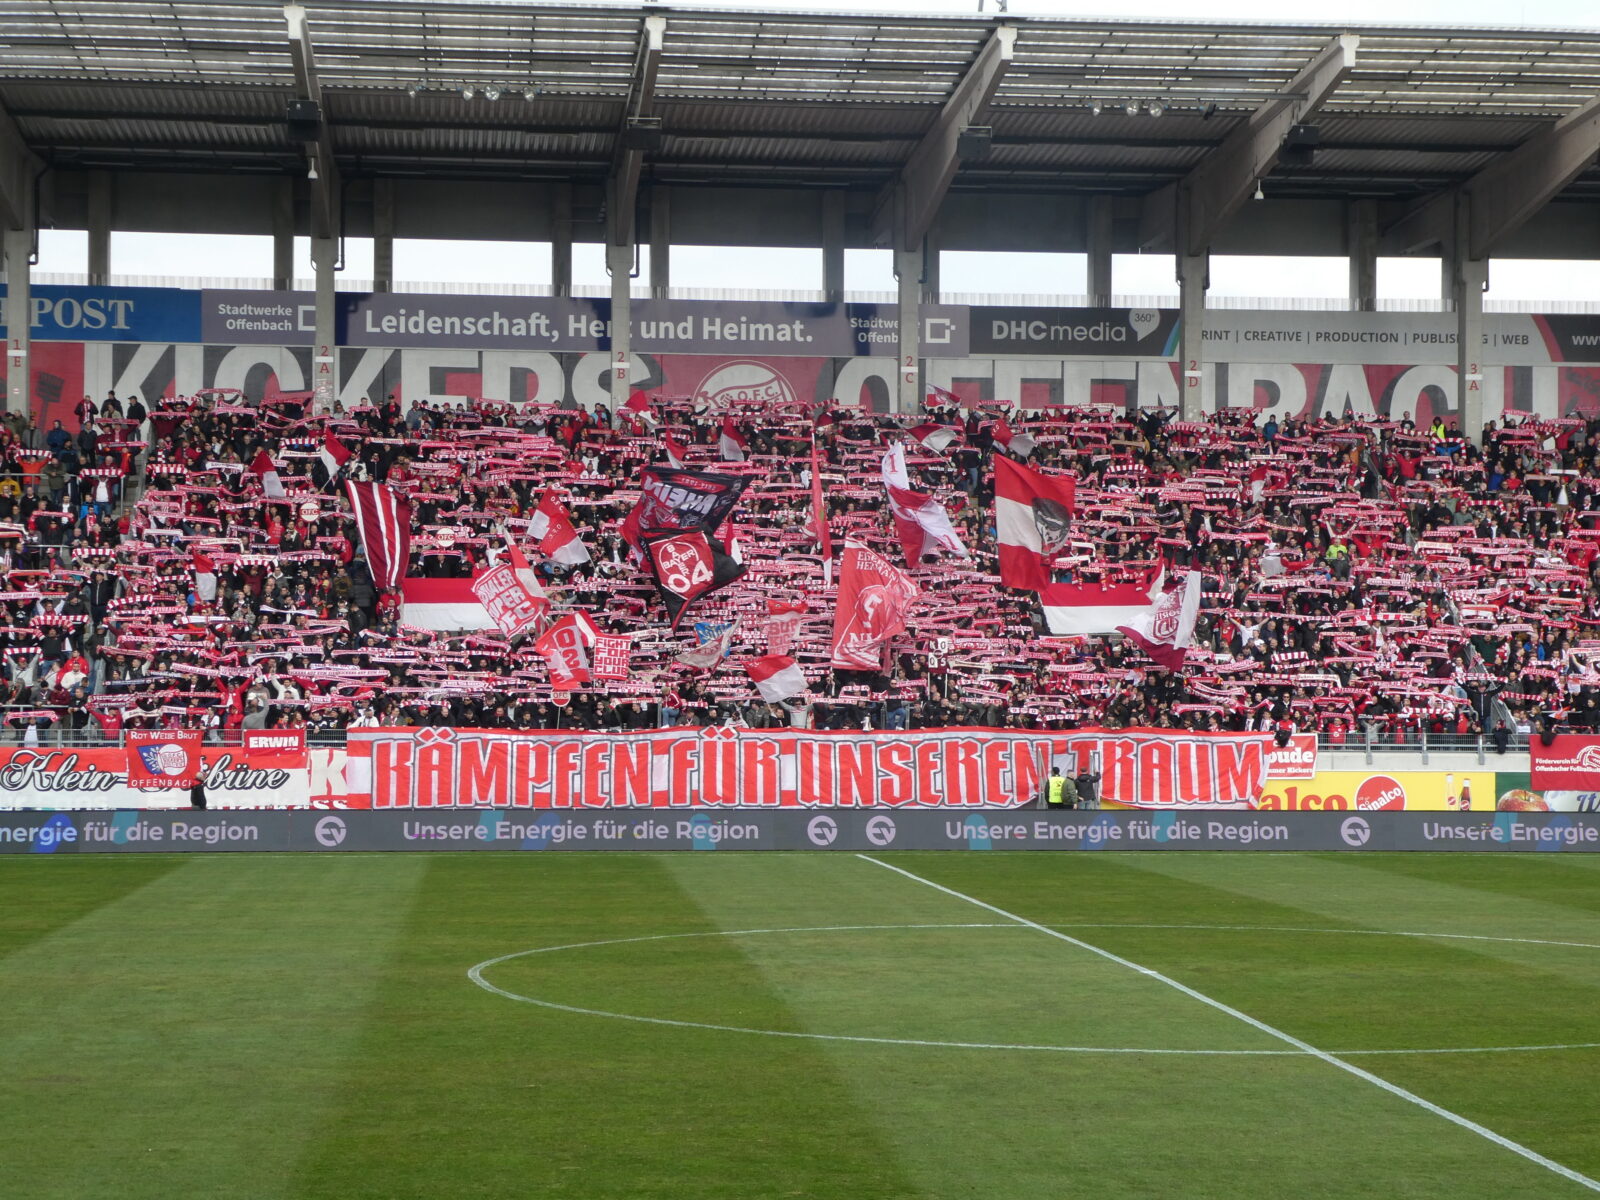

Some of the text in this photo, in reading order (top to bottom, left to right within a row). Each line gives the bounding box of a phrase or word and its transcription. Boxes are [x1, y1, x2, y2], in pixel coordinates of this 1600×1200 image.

[30, 297, 134, 330] POST
[217, 303, 293, 317] Stadtwerke
[225, 318, 293, 332] Offenbach
[365, 309, 813, 342] Leidenschaft, Her und Heimat.
[1244, 330, 1303, 343] CREATIVE
[1315, 331, 1399, 344] PRODUCTION
[1502, 334, 1530, 346] WEB
[1572, 335, 1600, 347] ww
[321, 345, 329, 357] 2
[617, 352, 625, 363] 2
[905, 356, 914, 368] 2
[319, 362, 330, 374] A
[1190, 360, 1198, 371] 2
[1470, 363, 1478, 375] 3
[617, 368, 626, 379] B
[905, 373, 914, 384] C
[1189, 376, 1199, 388] D
[1468, 380, 1479, 391] A
[249, 735, 299, 748] ERWIN
[372, 725, 1264, 809] KÄMPFEN FÜR UNSEREN TRAUM
[84, 821, 119, 841] für
[126, 821, 164, 841] die
[171, 821, 258, 846] Region
[403, 820, 760, 843] Unsere Energie für die Region
[945, 820, 1288, 843] Unsere Energie für die Region
[1424, 821, 1599, 845] Unsere Energie
